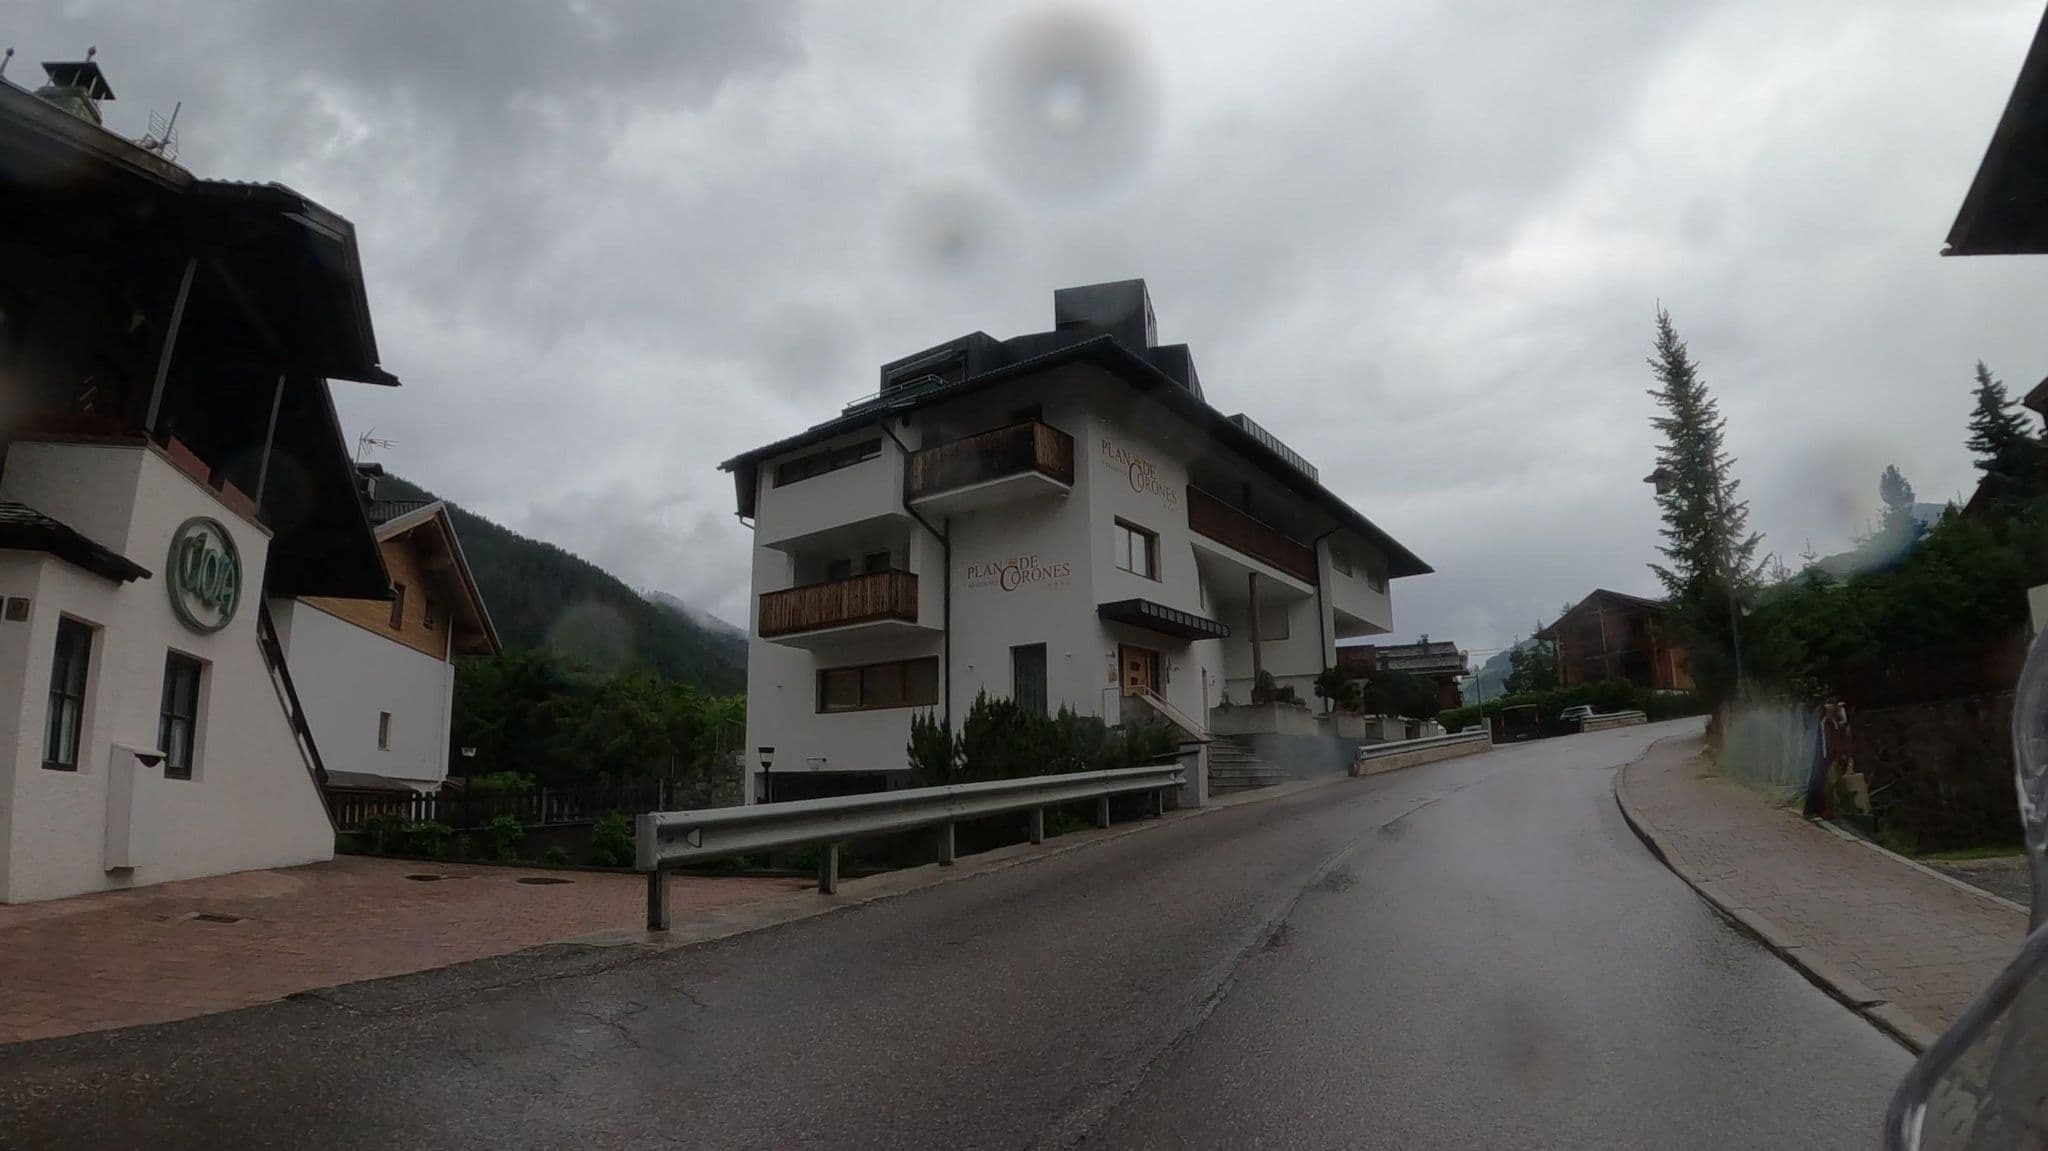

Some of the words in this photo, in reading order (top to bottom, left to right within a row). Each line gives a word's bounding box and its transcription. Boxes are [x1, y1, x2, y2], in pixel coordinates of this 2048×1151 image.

[1102, 440, 1130, 465] PLAN
[1142, 461, 1158, 480] DE
[1129, 463, 1177, 503] CORONES
[968, 562, 1002, 580] PLAN
[1020, 554, 1039, 570] DE
[1000, 563, 1071, 592] CORONES
